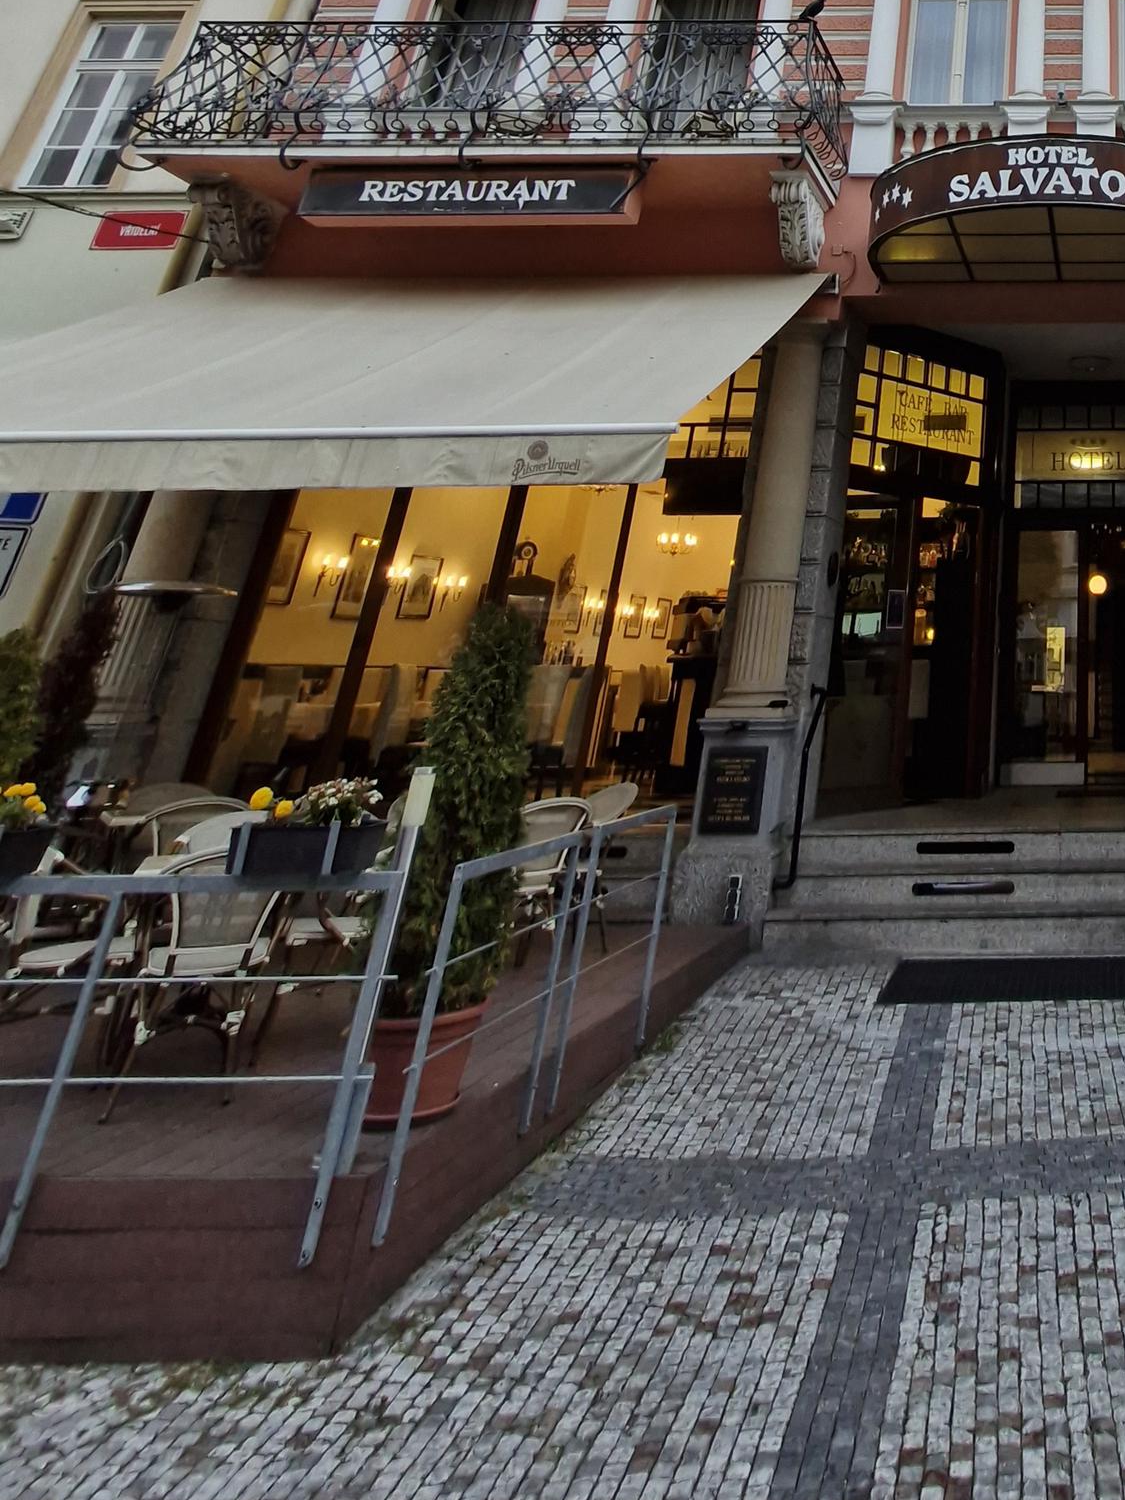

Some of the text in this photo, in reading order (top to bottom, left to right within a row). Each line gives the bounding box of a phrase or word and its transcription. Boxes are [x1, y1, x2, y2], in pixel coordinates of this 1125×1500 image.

[1007, 145, 1095, 167] HOTEL
[358, 176, 576, 211] RESTAURANT
[511, 456, 581, 483] Pilsner Urquell
